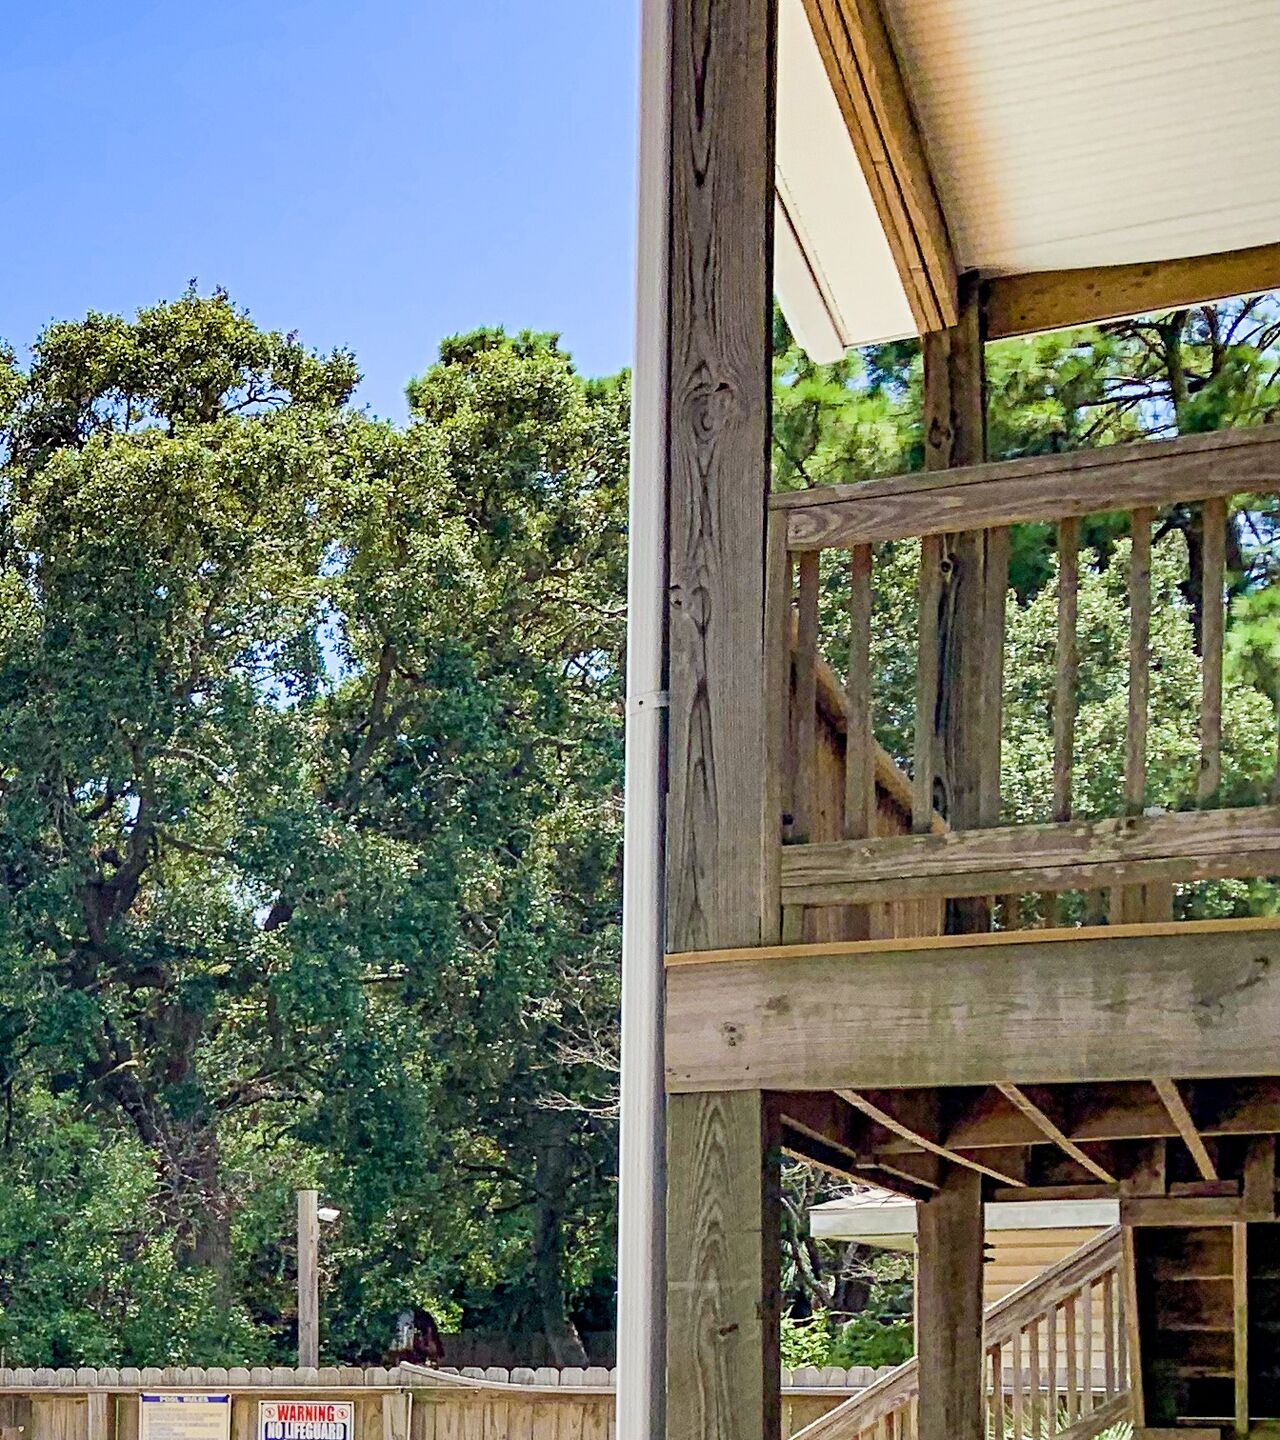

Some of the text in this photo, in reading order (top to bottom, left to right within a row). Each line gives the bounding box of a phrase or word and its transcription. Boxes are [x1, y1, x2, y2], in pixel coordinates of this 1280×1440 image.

[277, 1404, 335, 1422] WARNING
[267, 1422, 345, 1440] NO LIFEGUARD
